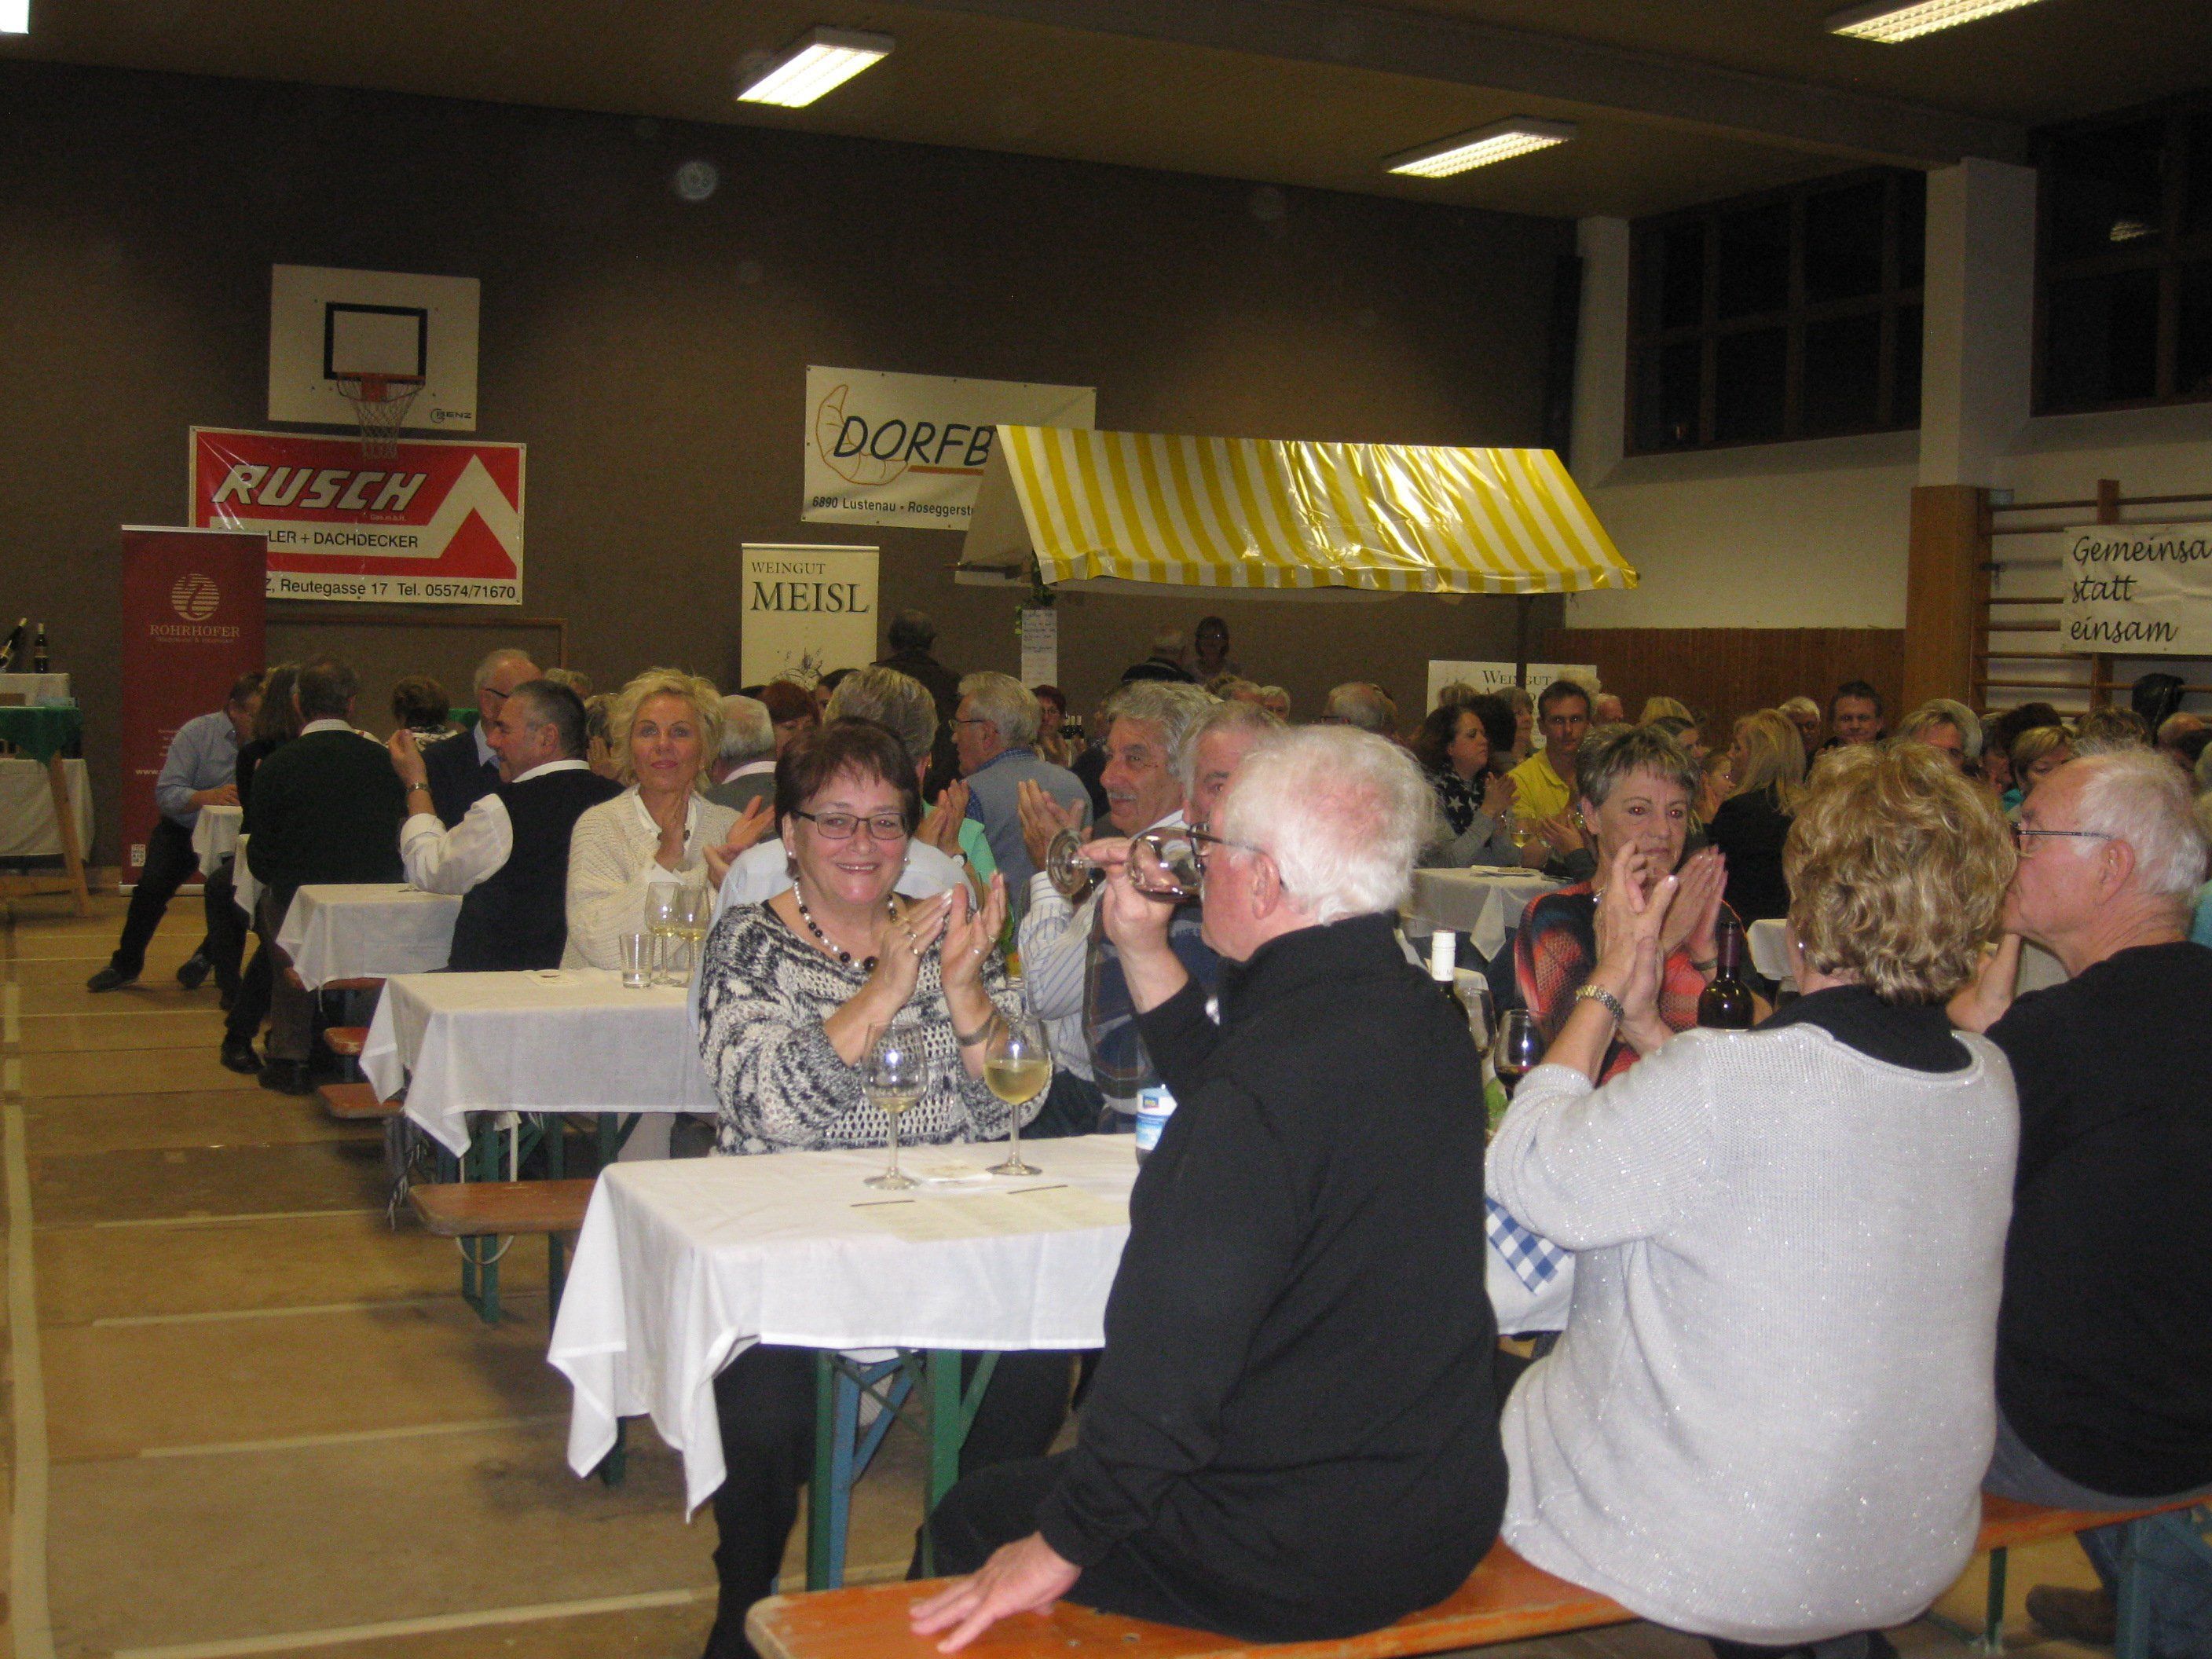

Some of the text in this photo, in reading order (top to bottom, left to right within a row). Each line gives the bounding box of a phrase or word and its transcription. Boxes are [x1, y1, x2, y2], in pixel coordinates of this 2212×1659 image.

[437, 411, 471, 419] BENZ
[211, 463, 427, 511] RUSCH
[812, 496, 838, 508] 6890
[843, 498, 896, 511] Lustenau
[314, 532, 418, 548] DACHDECKER
[752, 562, 826, 574] WEINGUT
[281, 578, 365, 596] Reutegasse
[372, 583, 388, 595] 17
[397, 583, 420, 595] Tel.
[426, 584, 515, 599] 05574/71670
[750, 581, 870, 613] MEISL
[2071, 575, 2138, 604] statt
[149, 624, 240, 637] ROHRHOFER
[2071, 616, 2179, 643] einsam
